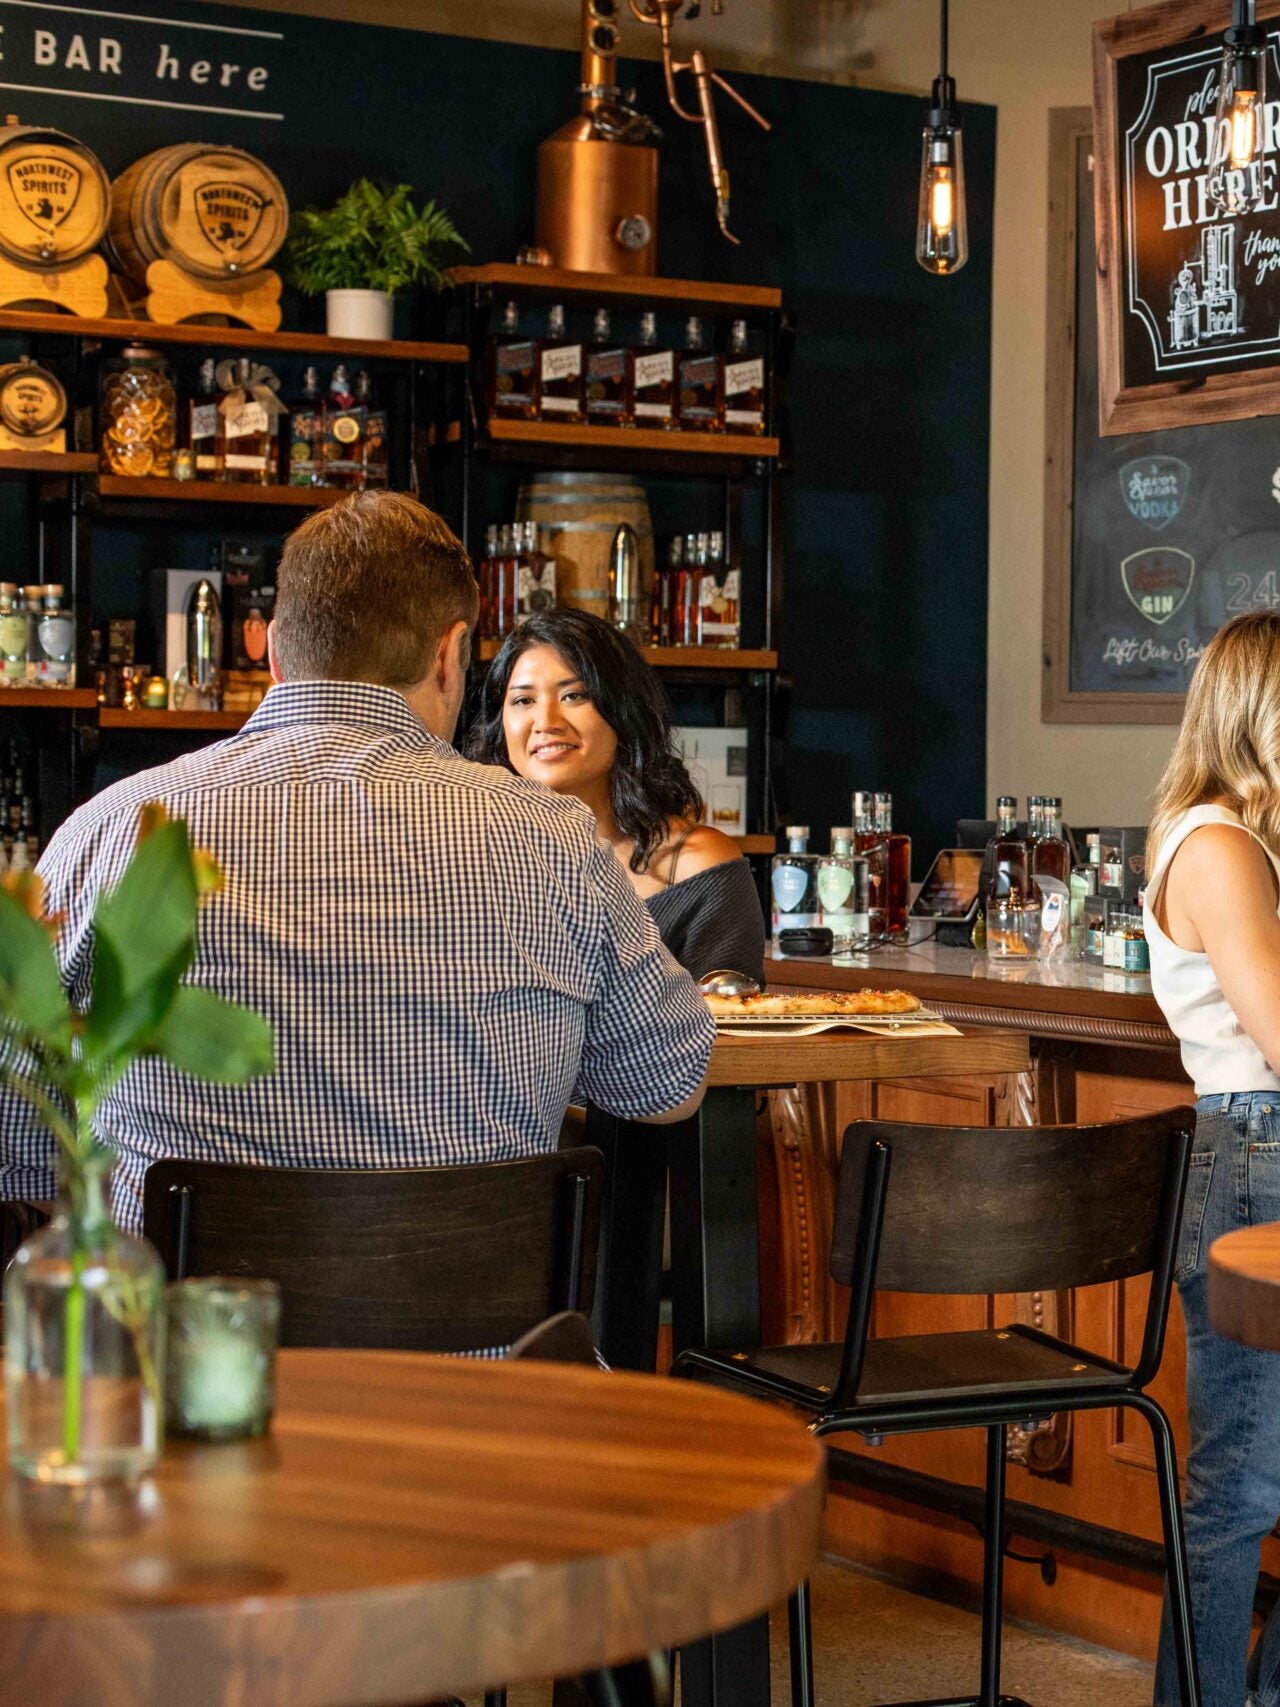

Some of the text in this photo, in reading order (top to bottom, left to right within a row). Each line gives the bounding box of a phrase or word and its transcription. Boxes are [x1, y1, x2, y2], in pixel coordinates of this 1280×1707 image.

[35, 29, 122, 75] BAR
[156, 44, 270, 91] here
[15, 163, 74, 181] NORTHWEST
[22, 180, 67, 195] SPIRITS
[1162, 159, 1279, 232] HERE
[1128, 500, 1180, 520] VODKA
[1141, 595, 1174, 614] GIN
[1102, 637, 1140, 667] Lift
